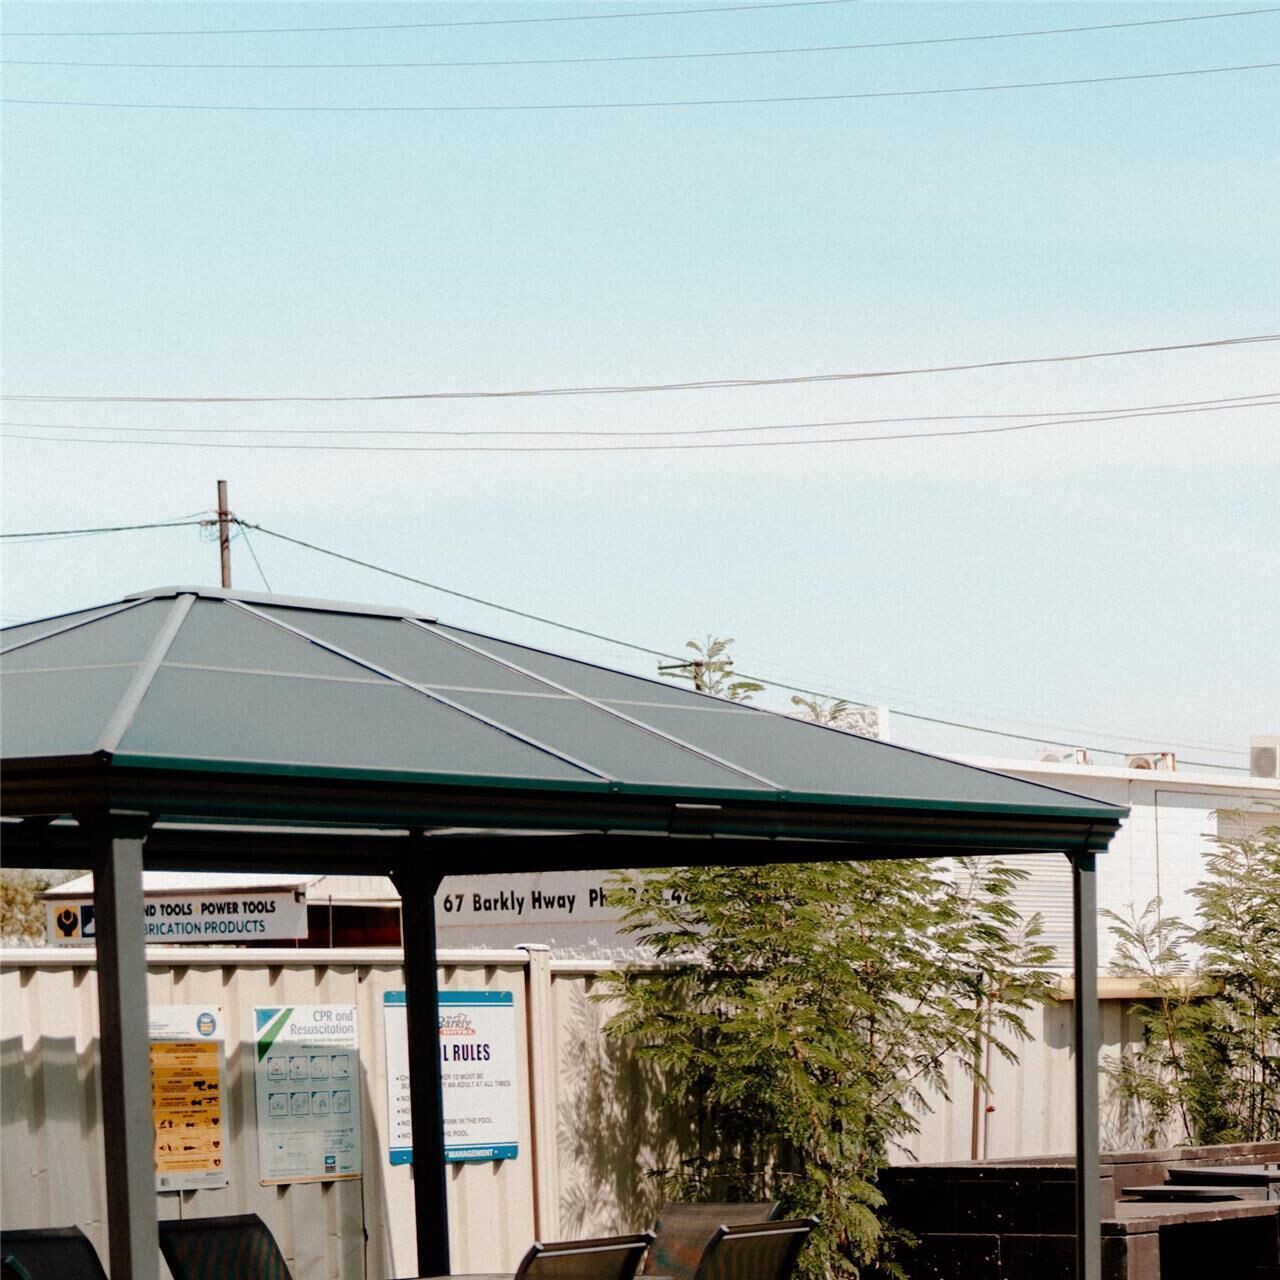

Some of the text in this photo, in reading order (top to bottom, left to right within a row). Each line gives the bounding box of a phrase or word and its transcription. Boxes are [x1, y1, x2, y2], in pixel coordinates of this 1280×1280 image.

[144, 900, 276, 917] ND TOOLS POWER TOOLS
[443, 895, 464, 912] 67
[473, 891, 524, 915] Barkly
[531, 890, 576, 914] Hway
[144, 919, 266, 936] BRICATION PRODUCTS
[312, 1010, 353, 1022] CPR and
[290, 1023, 354, 1035] Resuscitation
[453, 1044, 490, 1061] RULES
[448, 1149, 494, 1158] MANAGEMENT
